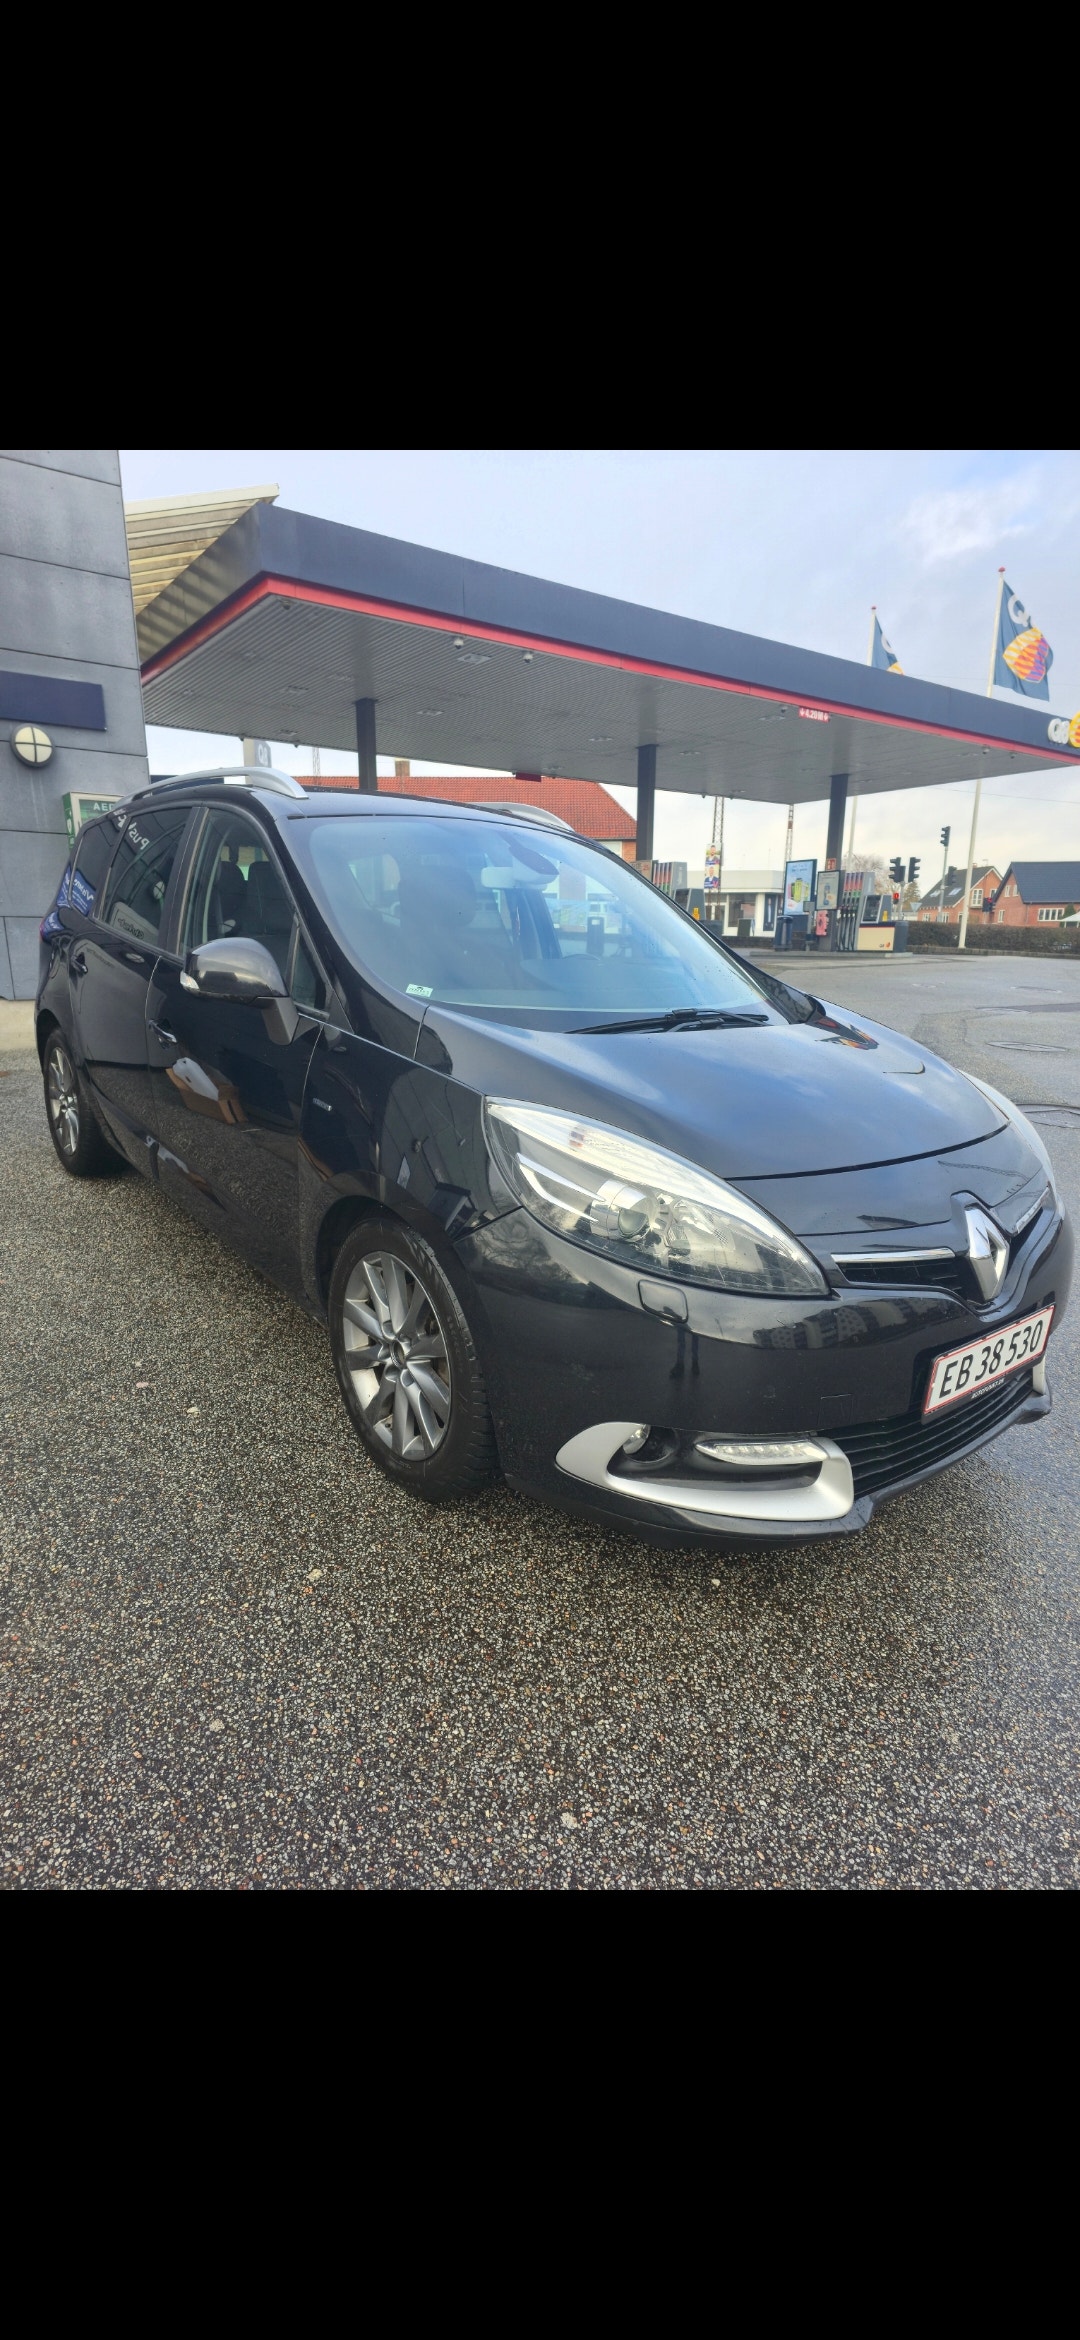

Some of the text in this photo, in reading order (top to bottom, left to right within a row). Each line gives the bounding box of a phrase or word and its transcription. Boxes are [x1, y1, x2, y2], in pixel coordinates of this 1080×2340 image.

[1048, 718, 1070, 744] Q8
[939, 1320, 1043, 1398] EB 38 530
